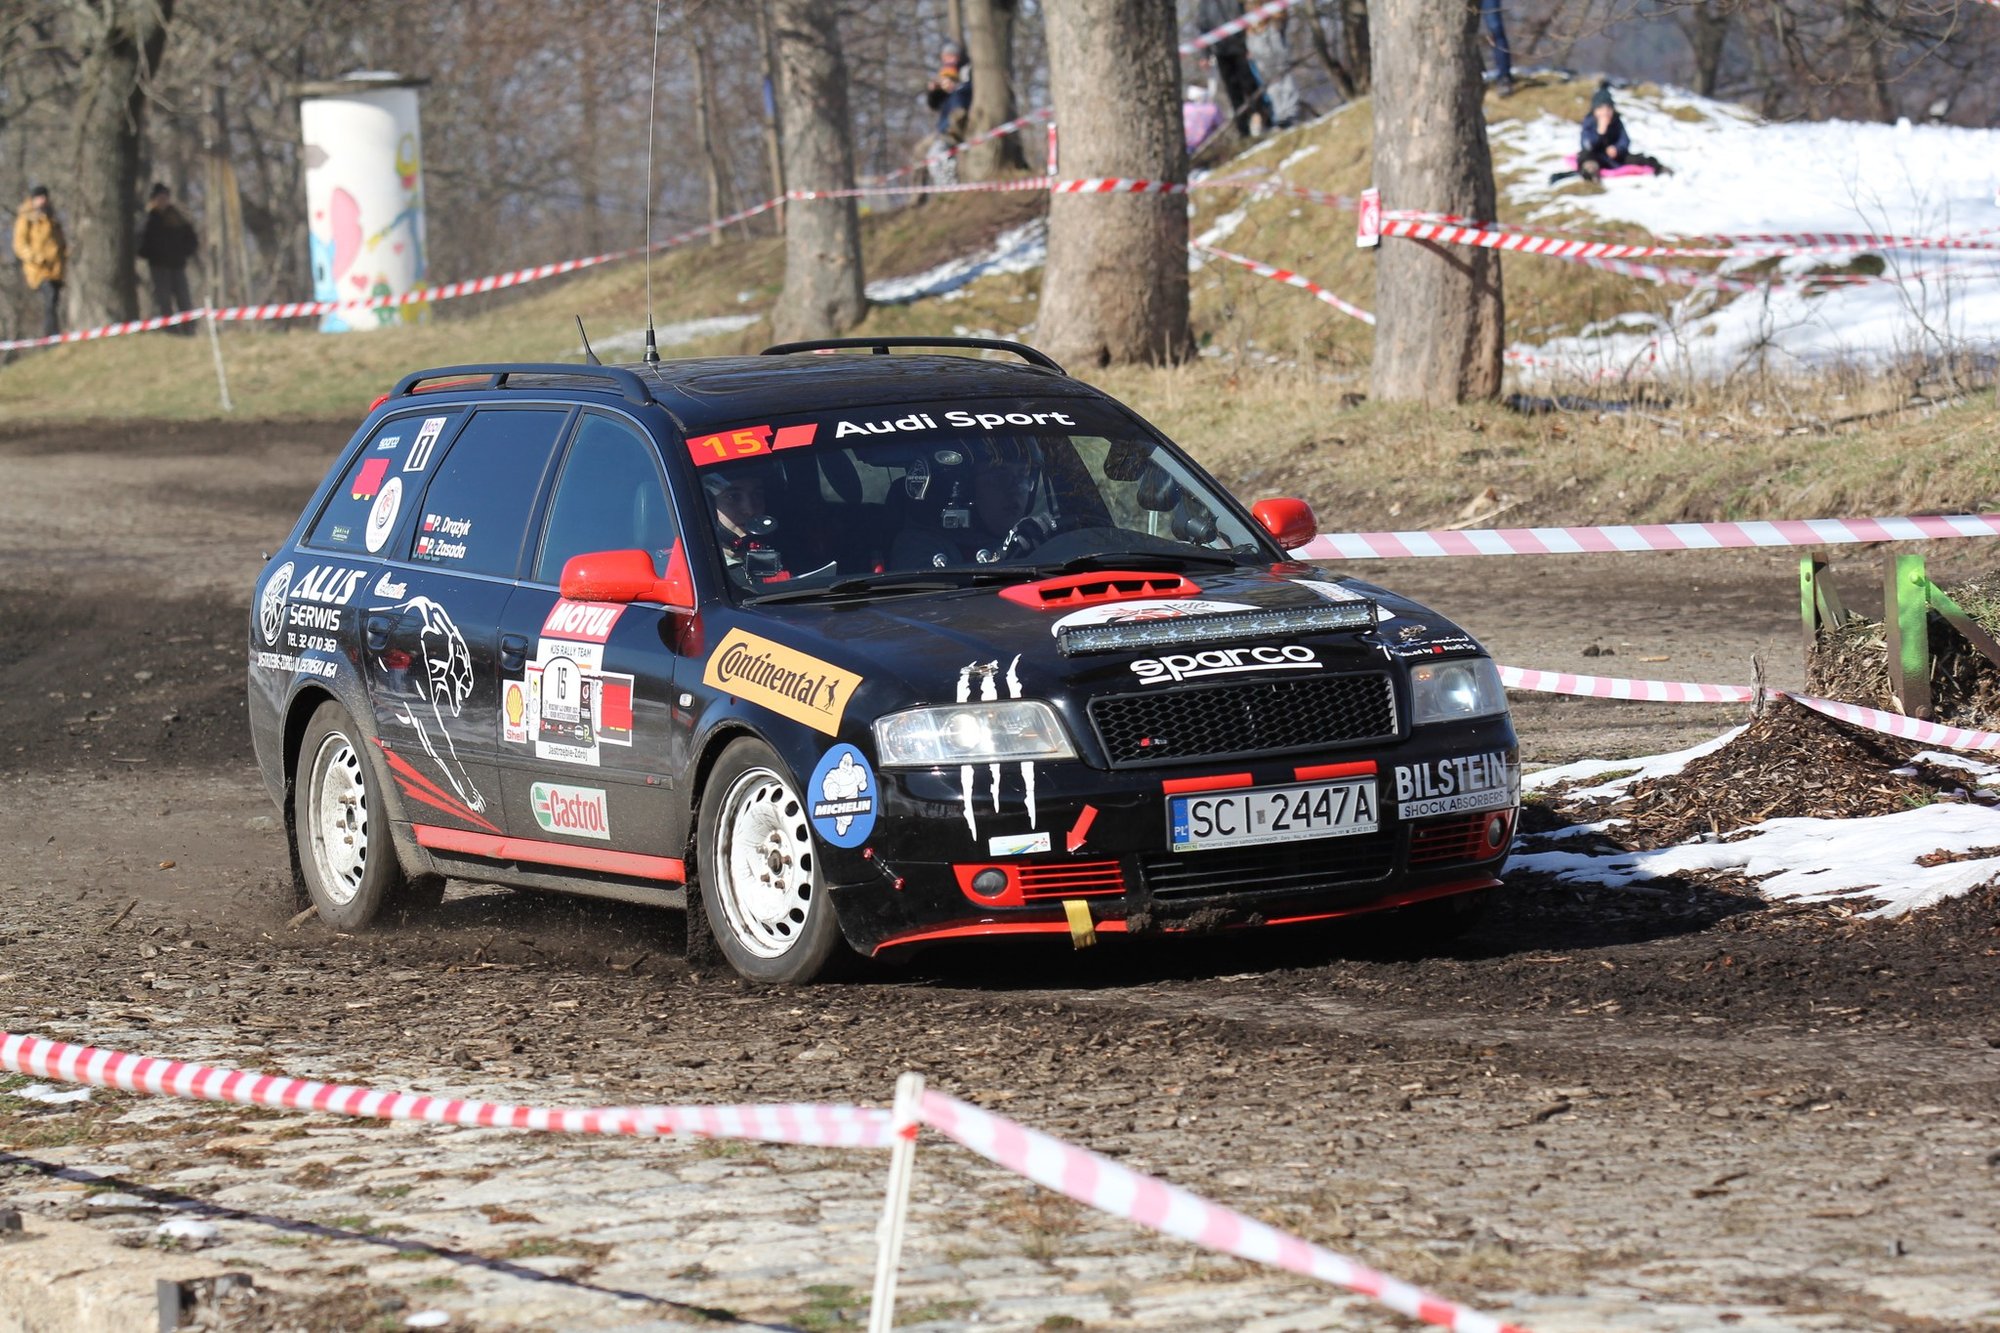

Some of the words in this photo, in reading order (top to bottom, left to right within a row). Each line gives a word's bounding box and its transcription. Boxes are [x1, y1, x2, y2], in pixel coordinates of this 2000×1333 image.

[835, 412, 937, 439] Audi
[944, 411, 1076, 430] Sport
[702, 432, 763, 457] 15
[432, 515, 442, 532] P.
[426, 538, 435, 555] P.
[434, 539, 467, 559] Zasada
[289, 565, 368, 605] ALUS
[289, 603, 341, 632] SERWIS
[545, 602, 618, 637] MOTUL
[287, 632, 297, 647] TEL
[298, 633, 307, 648] 32
[560, 646, 576, 657] RALLY
[577, 647, 592, 659] TEAM
[717, 642, 826, 707] Continental
[1129, 645, 1323, 686] sparco
[557, 667, 568, 700] 15
[506, 729, 525, 741] Shell
[1394, 751, 1508, 801] BILSTEIN
[550, 789, 606, 832] Castrol
[814, 800, 871, 816] MICHELIN
[1270, 784, 1373, 831] 2447A
[1404, 801, 1448, 818] SHOCK
[1449, 790, 1504, 811] ABSORBERS
[1174, 825, 1188, 836] PL
